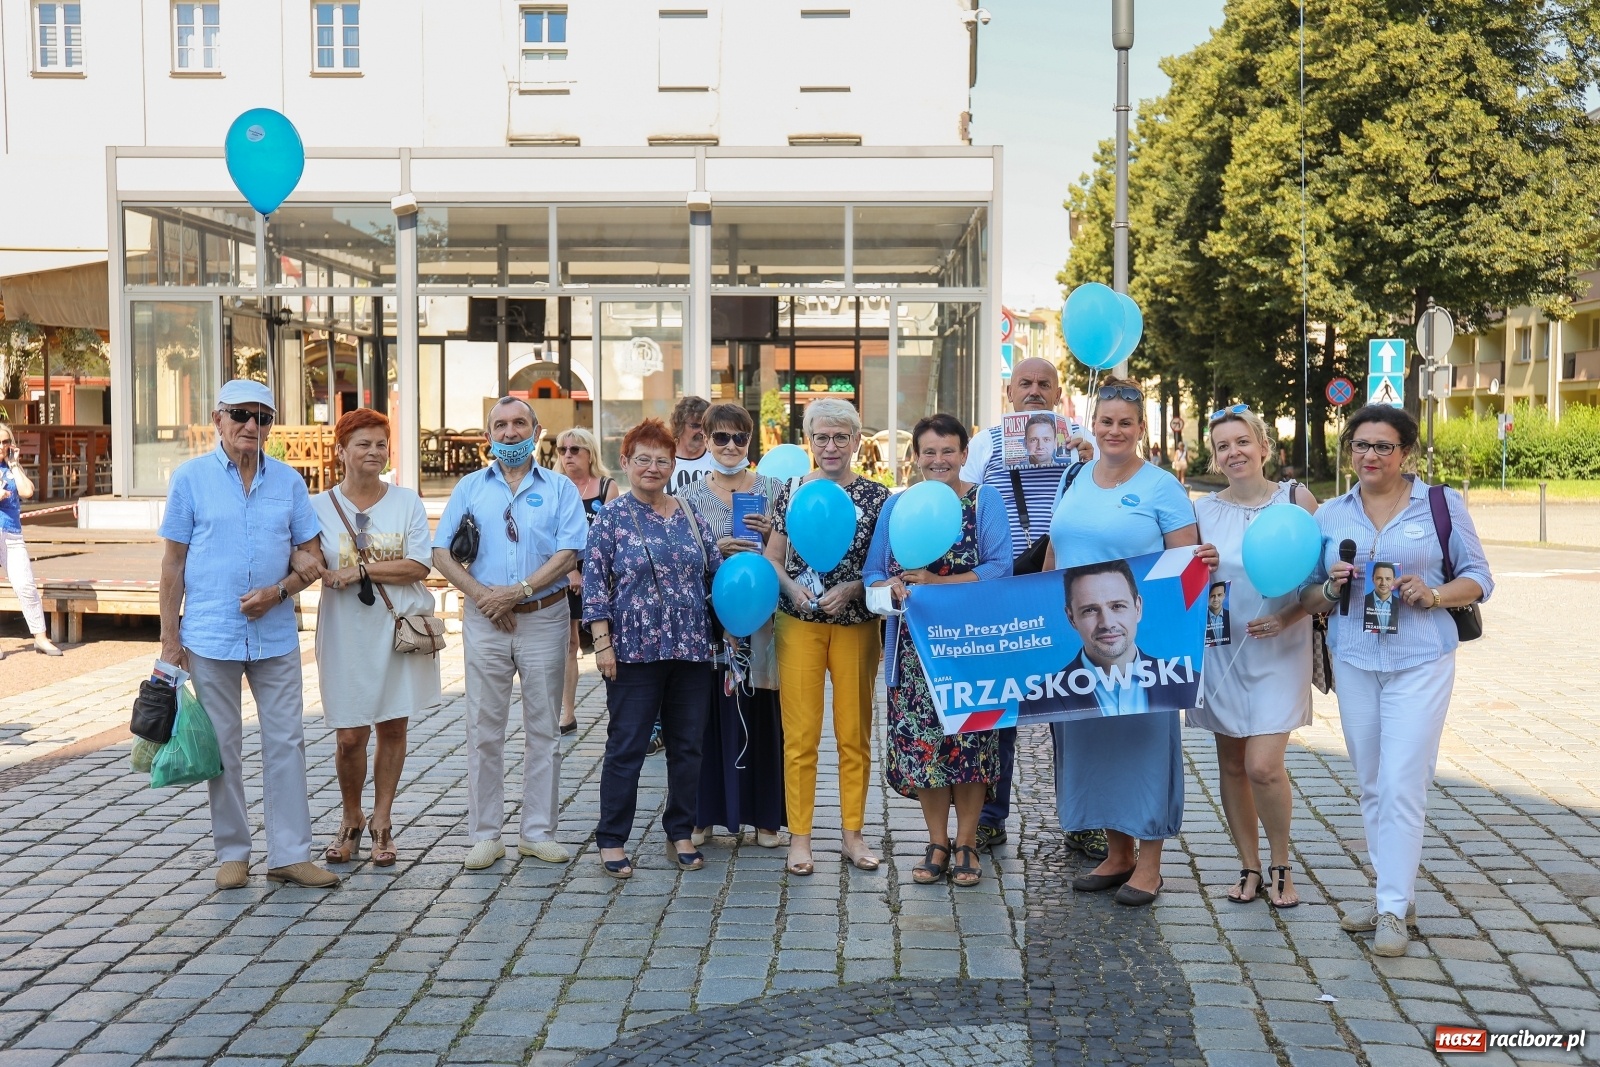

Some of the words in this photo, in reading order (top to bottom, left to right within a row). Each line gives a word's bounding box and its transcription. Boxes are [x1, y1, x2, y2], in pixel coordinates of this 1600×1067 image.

[928, 624, 961, 641] Silny
[965, 615, 1045, 637] Prezydent
[930, 639, 995, 658] Wspólna
[999, 633, 1052, 652] Polska
[933, 675, 953, 683] RAFAŁ
[934, 655, 1194, 711] TRZASKOWSKI
